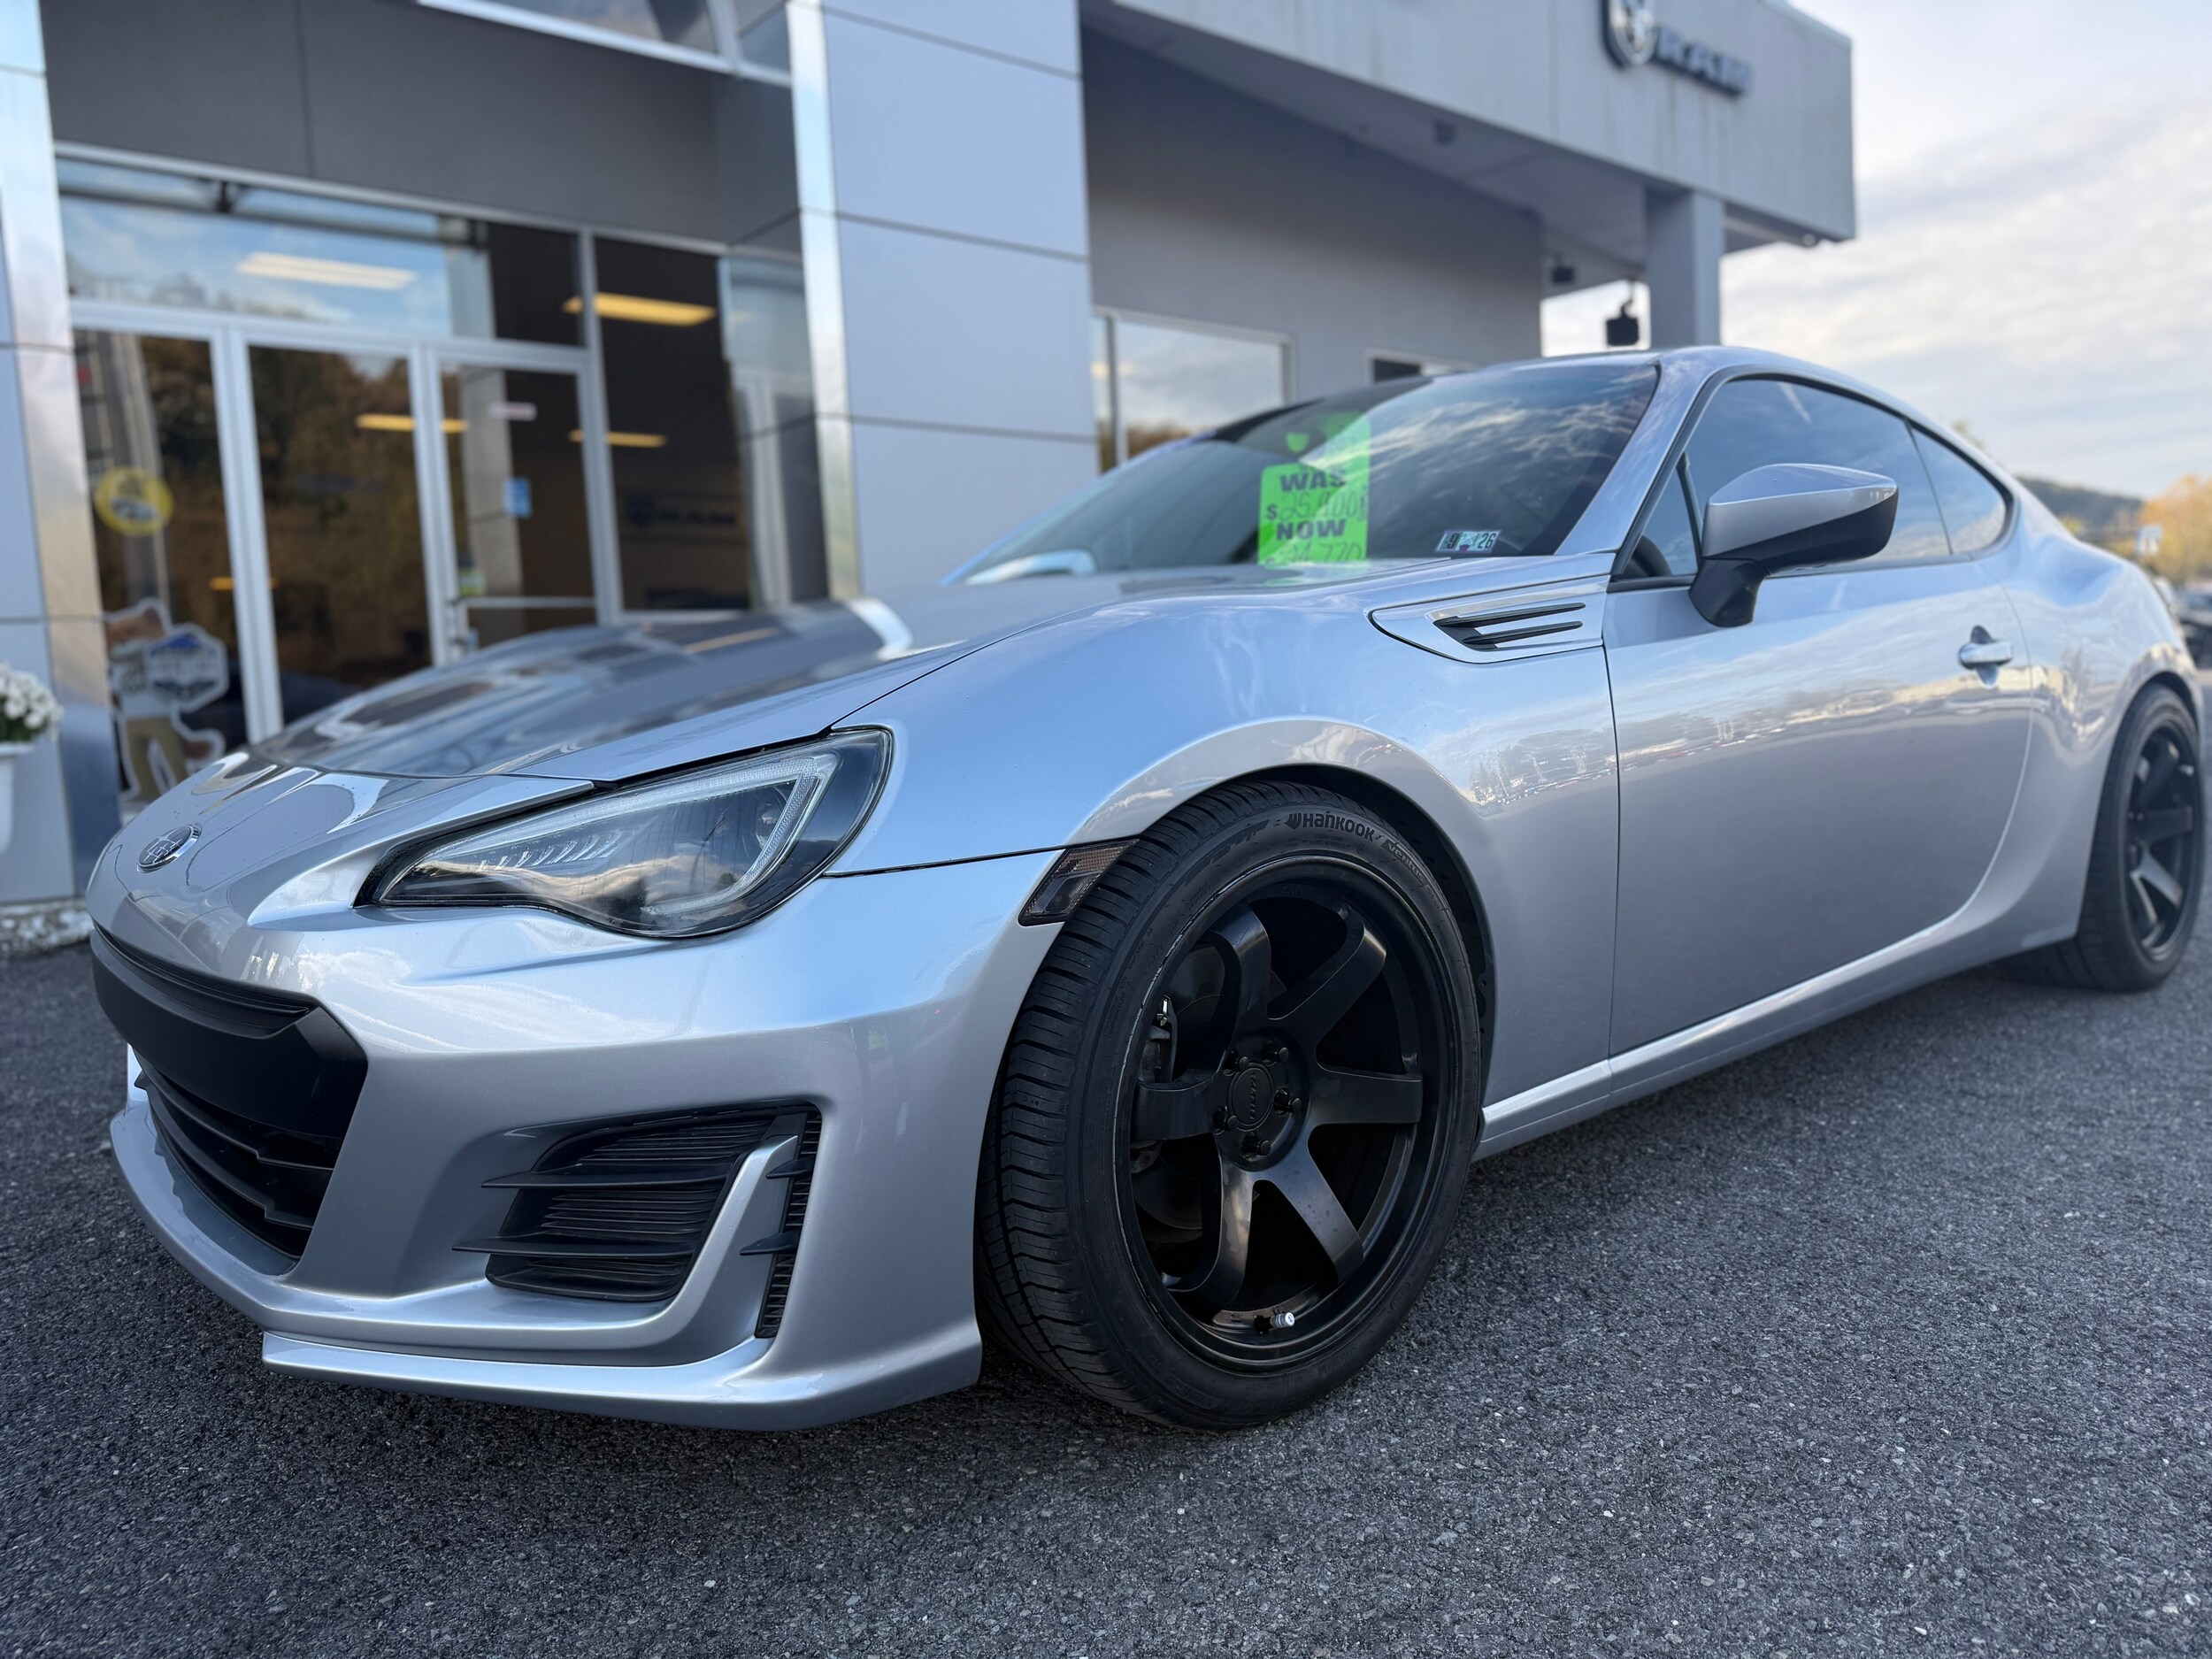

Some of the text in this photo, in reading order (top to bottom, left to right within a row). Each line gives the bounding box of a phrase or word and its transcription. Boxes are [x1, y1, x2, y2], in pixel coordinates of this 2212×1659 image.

[1279, 468, 1346, 492] WAS
[1277, 518, 1346, 541] NOW
[1477, 533, 1496, 549] 26
